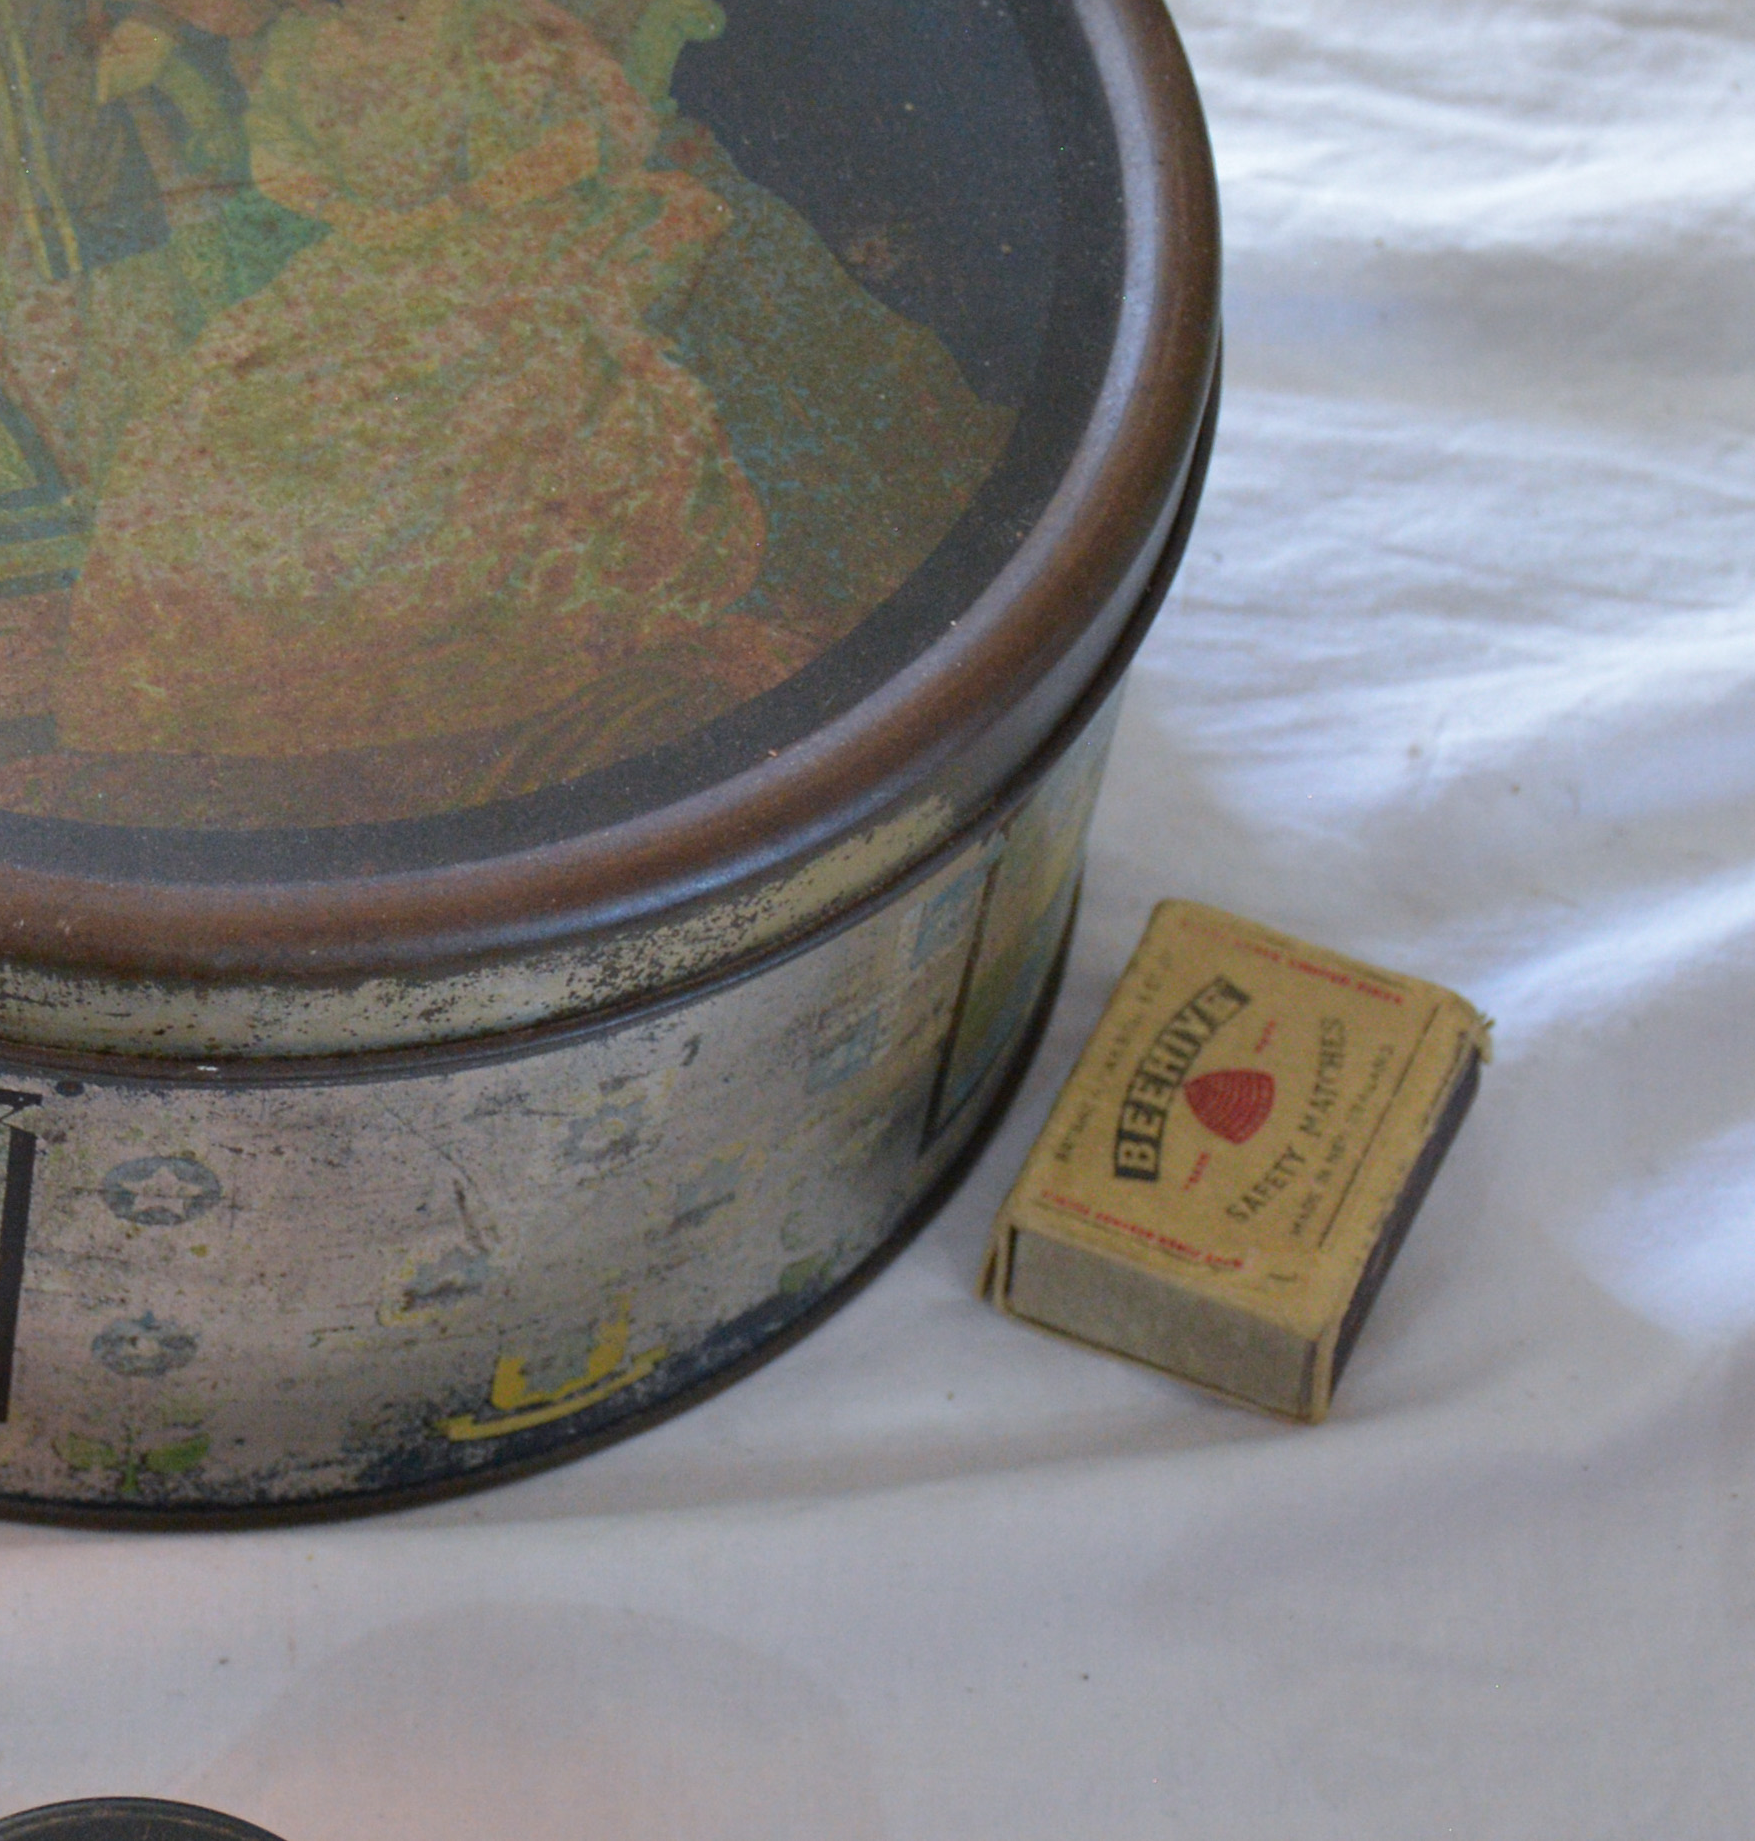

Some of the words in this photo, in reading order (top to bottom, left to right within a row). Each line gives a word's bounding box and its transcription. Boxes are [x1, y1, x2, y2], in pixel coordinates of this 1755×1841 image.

[1118, 981, 1242, 1169] BEEHIVE
[1226, 1146, 1305, 1224] SAFETY
[1300, 1016, 1347, 1138] MATCHES
